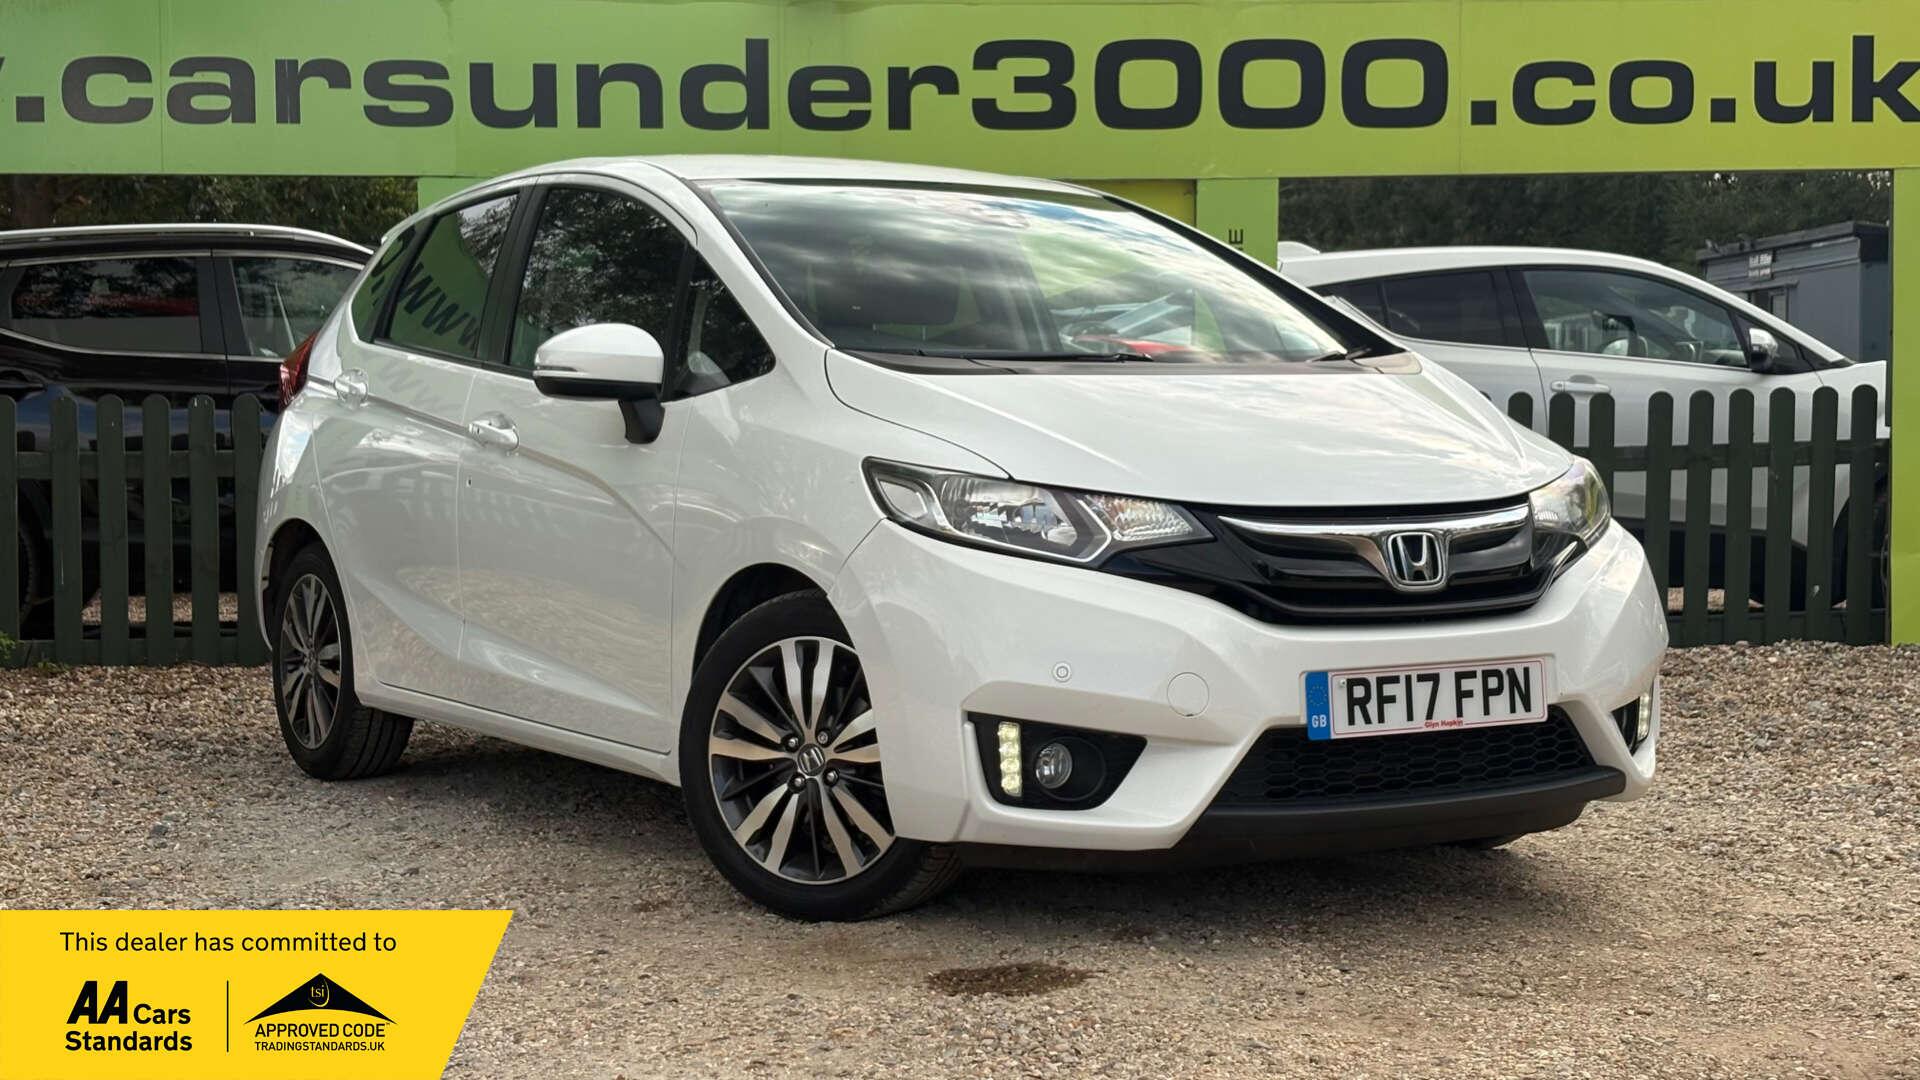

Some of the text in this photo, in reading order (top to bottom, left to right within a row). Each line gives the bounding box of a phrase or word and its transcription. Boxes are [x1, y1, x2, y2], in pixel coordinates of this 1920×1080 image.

[0, 35, 1920, 131] .carsunder3000.co.uk
[1311, 714, 1327, 728] GB
[1346, 666, 1532, 726] RF17 FPN
